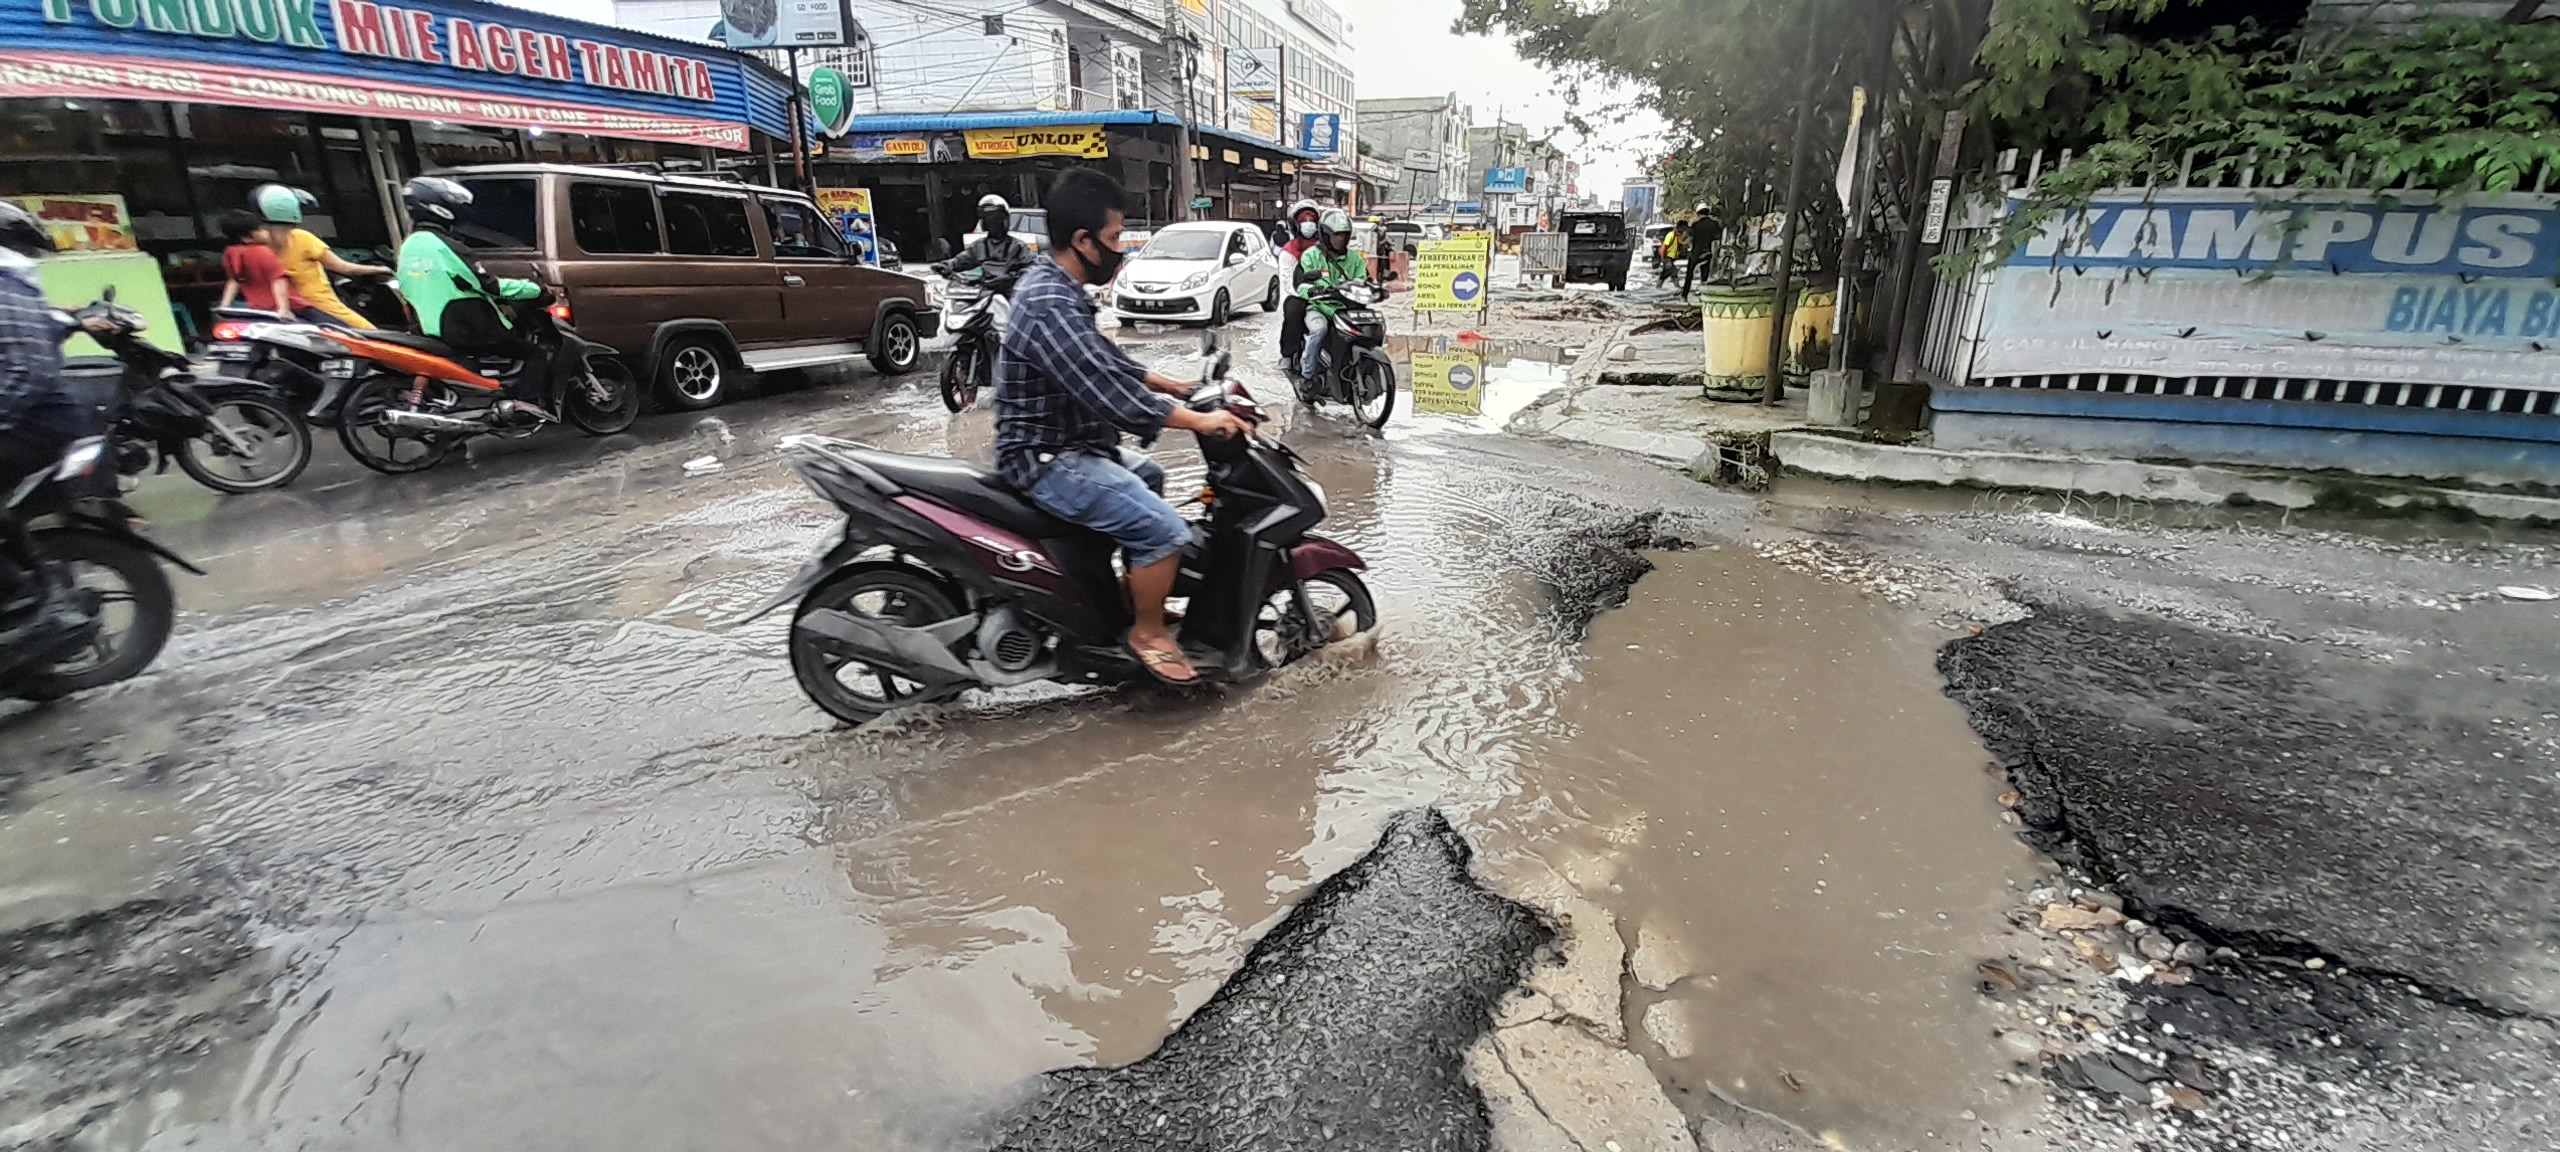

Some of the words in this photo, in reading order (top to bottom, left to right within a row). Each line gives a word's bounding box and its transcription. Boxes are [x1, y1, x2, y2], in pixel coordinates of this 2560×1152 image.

[332, 0, 443, 63] MIE
[447, 17, 574, 82] ACEH
[574, 38, 717, 101] TAMITA
[230, 76, 369, 105] LONTONG
[374, 90, 463, 114] MEDAN
[814, 84, 836, 96] Grab
[815, 95, 837, 106] Food
[1003, 130, 1085, 148] UNLOP
[2025, 207, 2541, 268] KAMPUS
[2385, 286, 2509, 335] BIAYA
